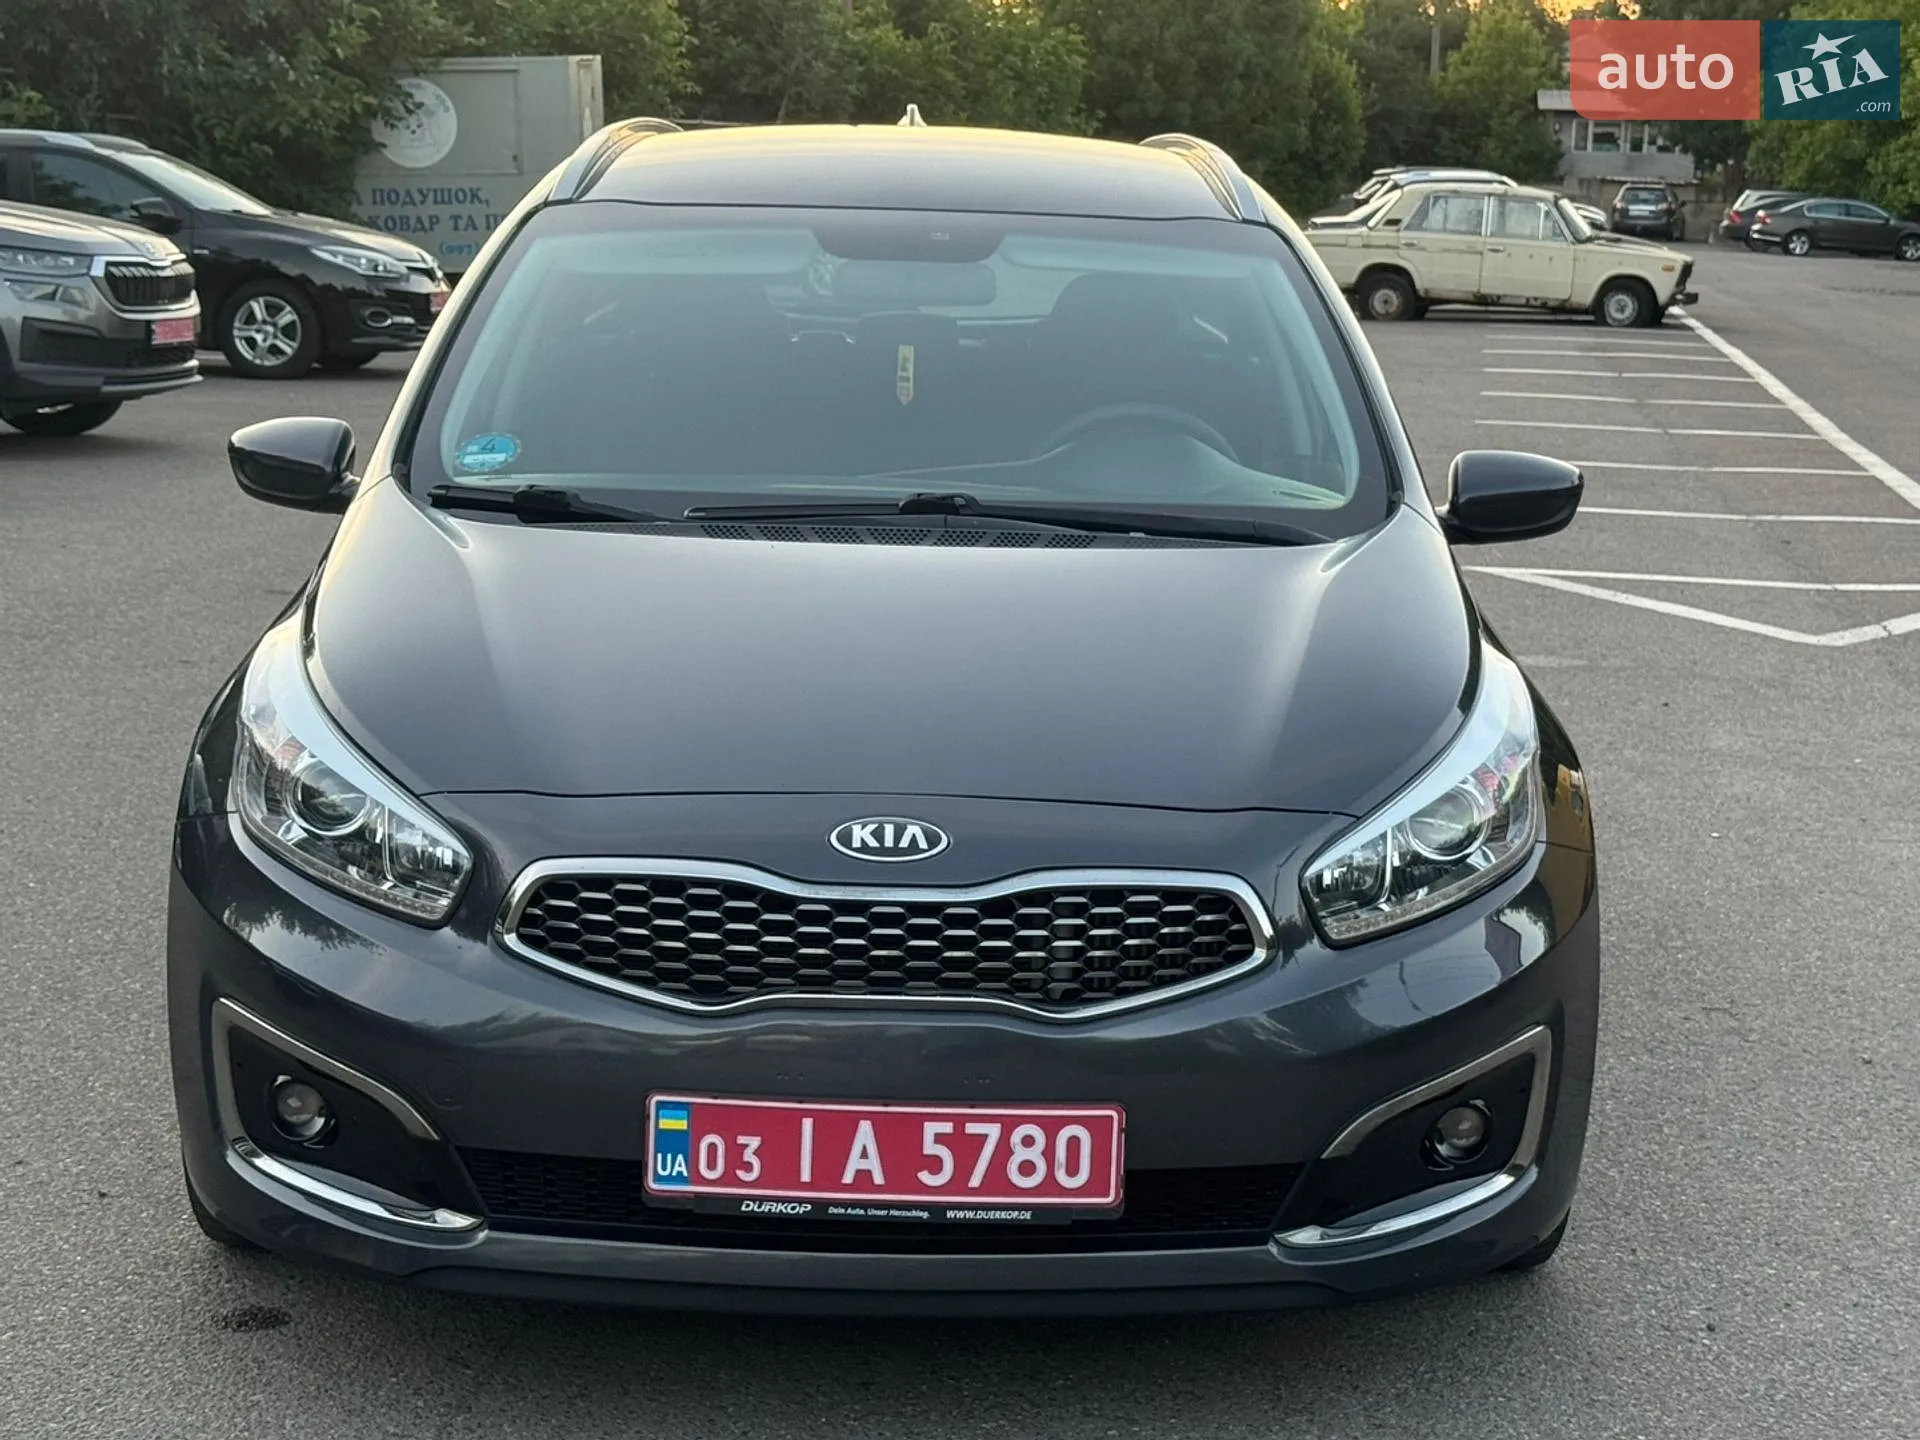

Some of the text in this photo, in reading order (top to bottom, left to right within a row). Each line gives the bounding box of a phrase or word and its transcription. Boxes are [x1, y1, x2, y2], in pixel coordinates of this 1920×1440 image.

[371, 187, 489, 207] ПОДУШОК,
[449, 214, 479, 232] ТА
[851, 823, 929, 850] KIA
[657, 1153, 688, 1177] UA
[698, 1134, 762, 1182] 03
[916, 1121, 1093, 1189] 5780
[946, 1209, 1033, 1219] WWW.DUERKOP.DE
